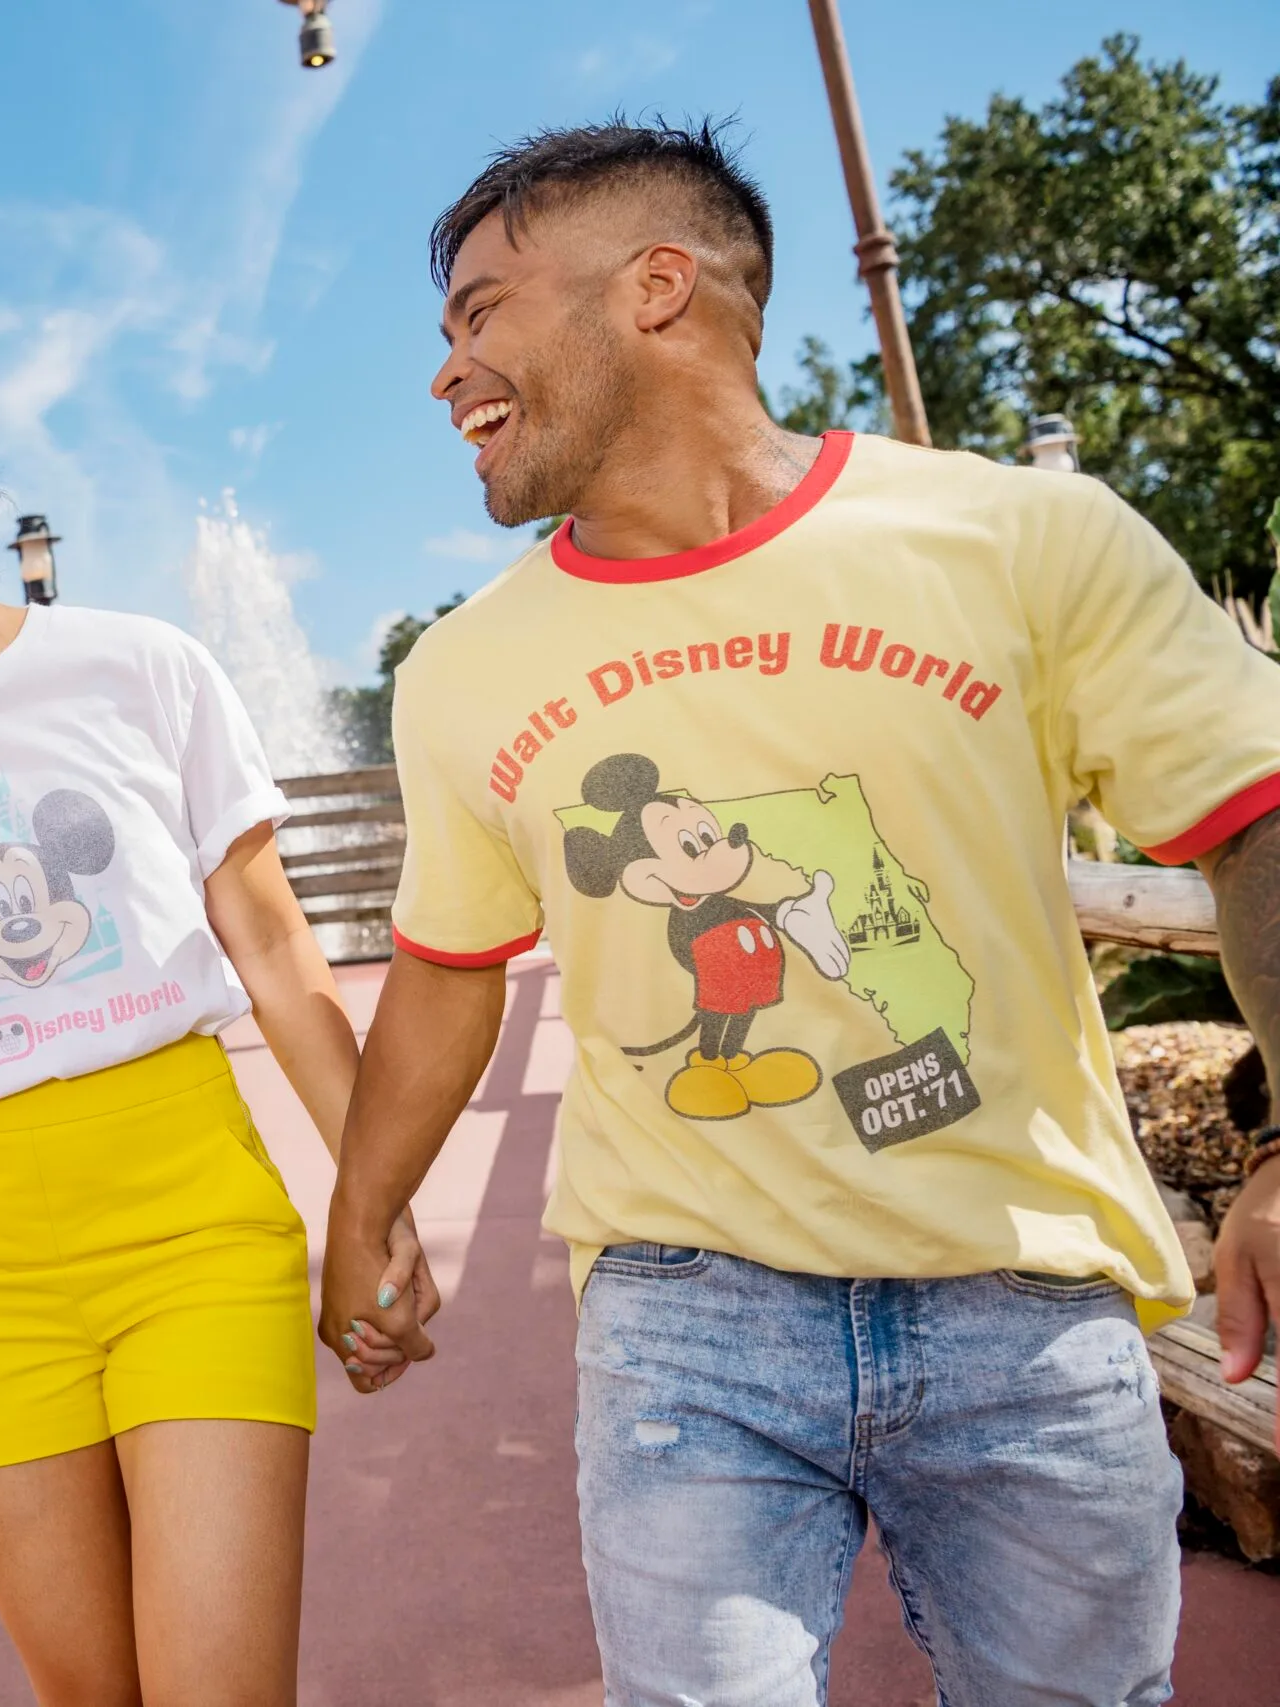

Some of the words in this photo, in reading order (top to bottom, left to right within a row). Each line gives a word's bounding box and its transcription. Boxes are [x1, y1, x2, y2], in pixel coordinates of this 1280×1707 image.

[488, 696, 578, 804] Walt
[586, 632, 792, 708] Disney
[819, 623, 1004, 722] World
[107, 979, 187, 1024] World
[861, 1093, 927, 1136] OCT.
[923, 1068, 965, 1108] '71
[864, 1052, 941, 1100] OPENS
